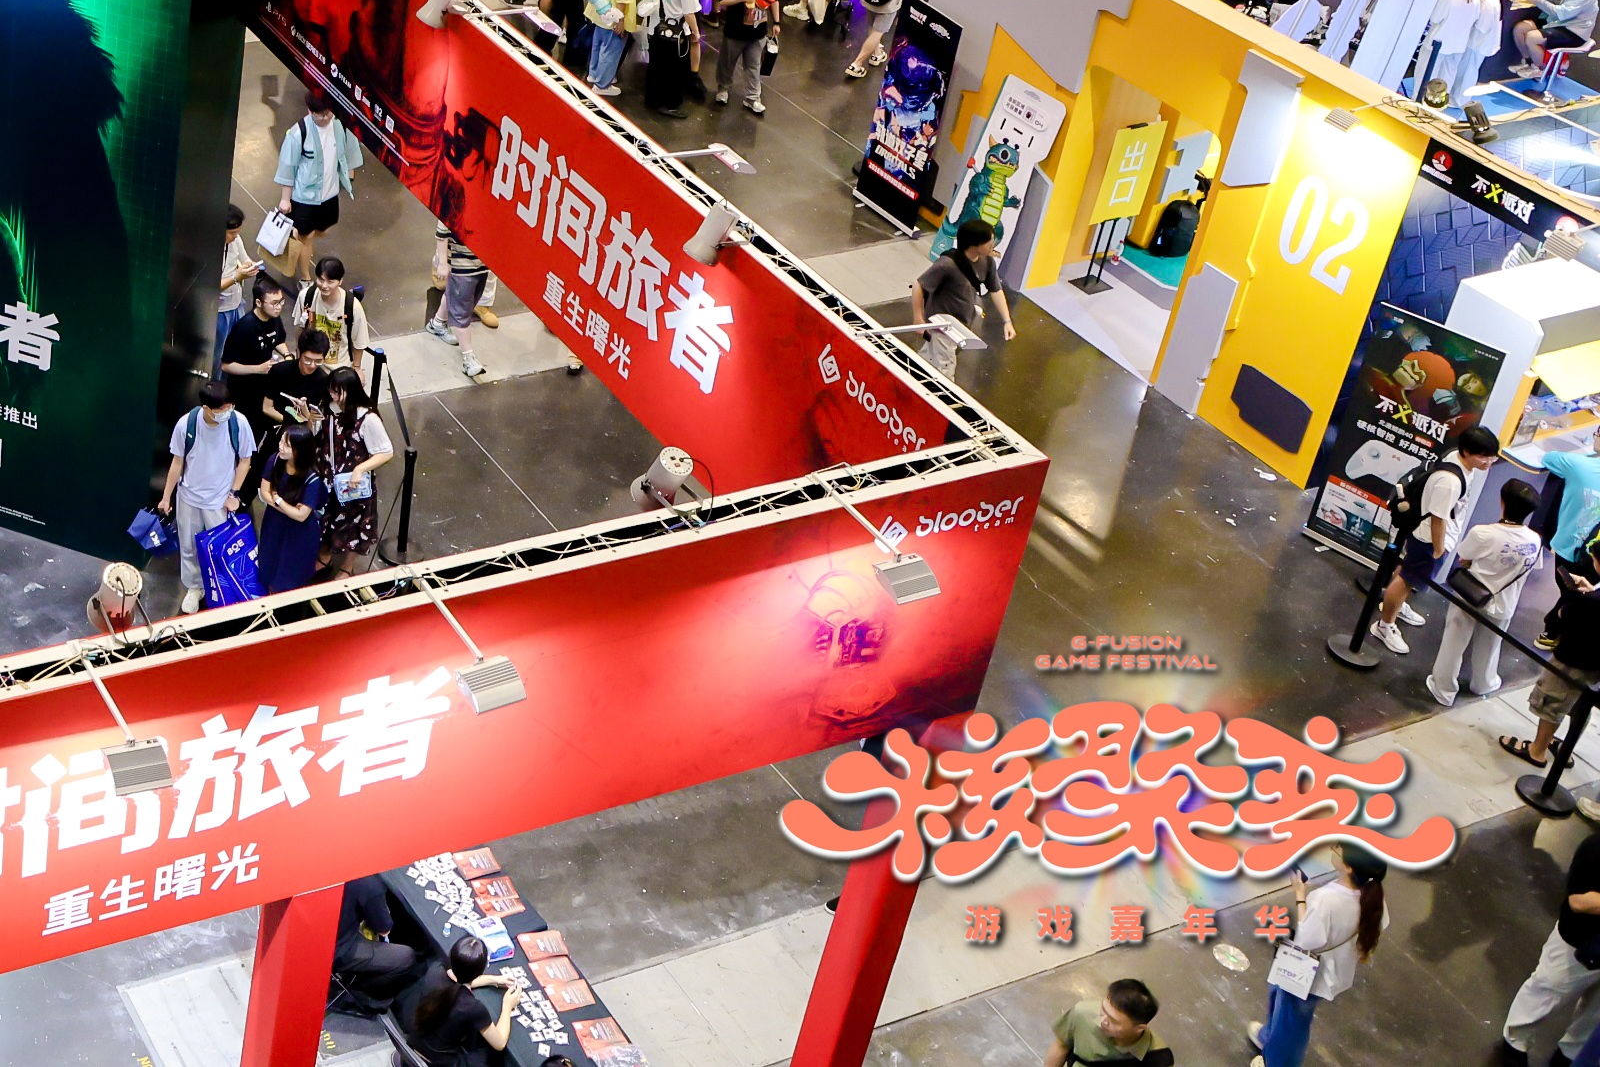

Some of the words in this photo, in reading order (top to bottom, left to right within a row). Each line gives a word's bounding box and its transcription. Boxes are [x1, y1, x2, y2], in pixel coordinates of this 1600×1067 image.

[492, 115, 735, 395] 时间旅者
[1279, 174, 1371, 295] 02
[542, 270, 632, 381] 重生曙光
[226, 538, 245, 556] BOE
[916, 494, 1025, 539] bloober
[973, 515, 1015, 532] team
[41, 843, 261, 938] 重生曙光
